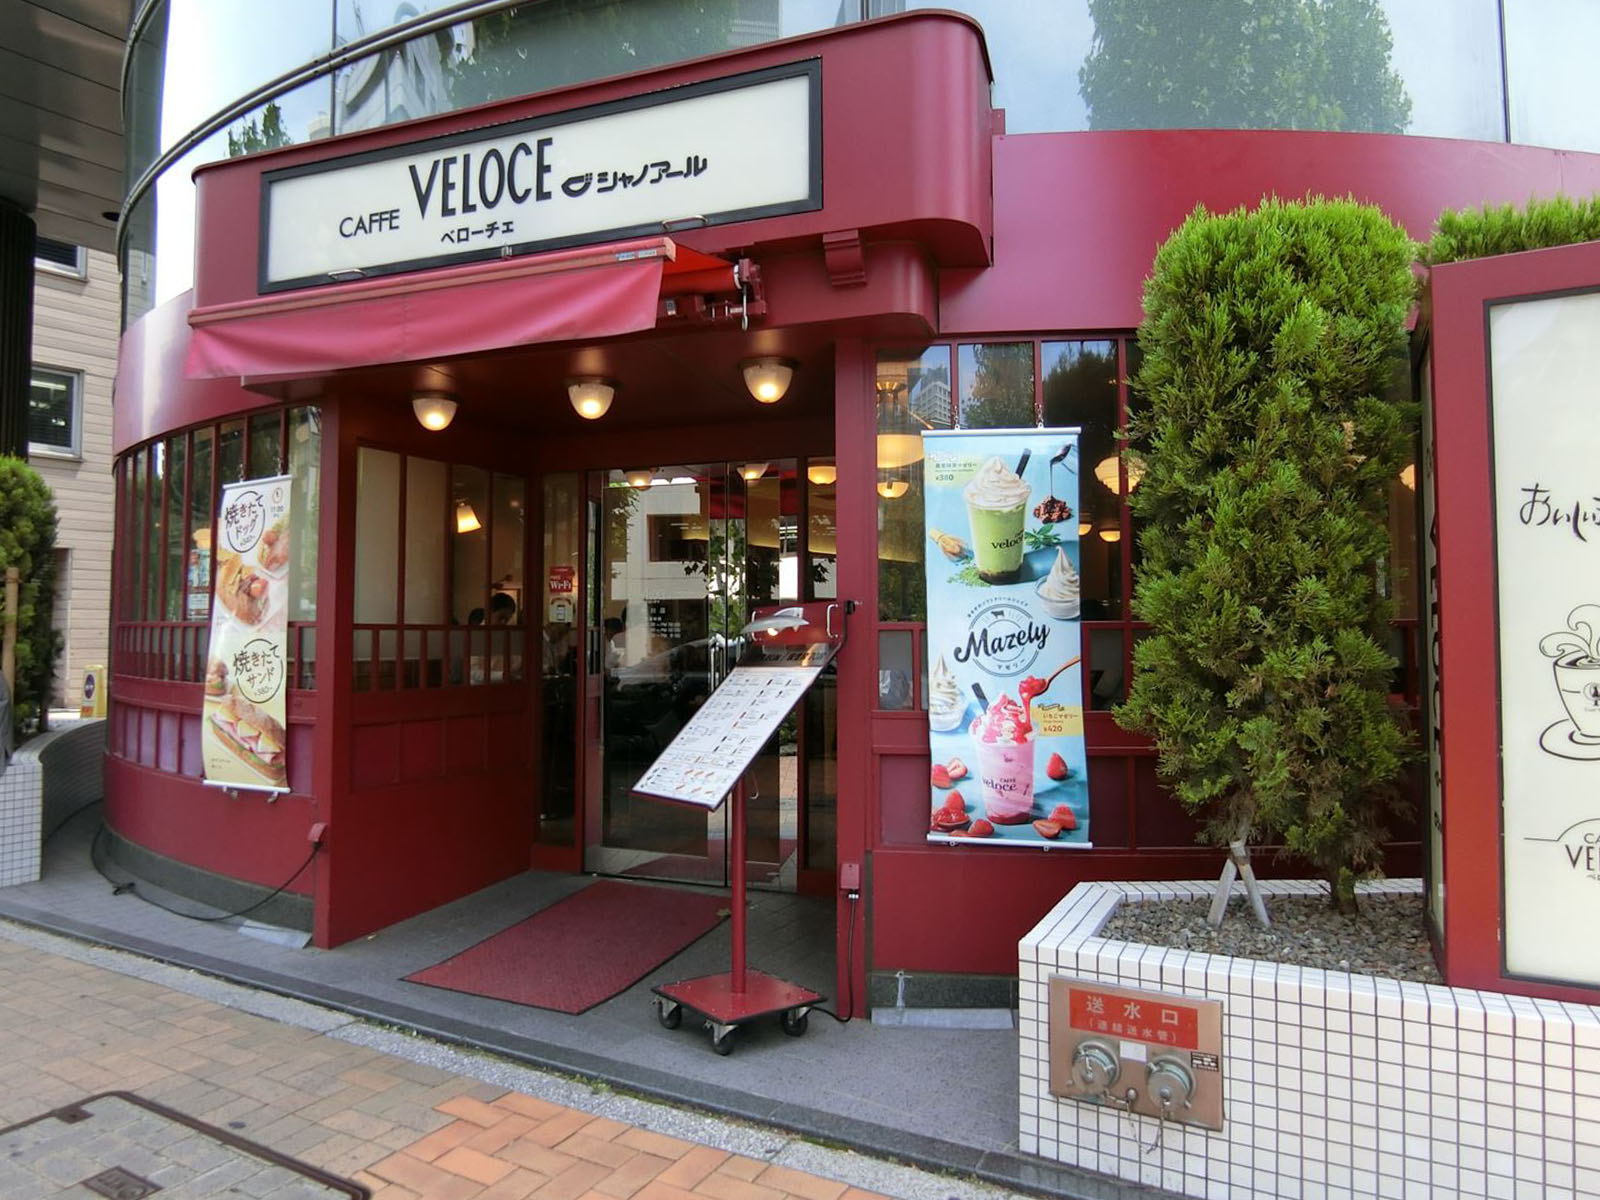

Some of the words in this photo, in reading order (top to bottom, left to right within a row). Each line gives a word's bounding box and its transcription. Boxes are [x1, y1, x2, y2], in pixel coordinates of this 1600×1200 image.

[339, 208, 401, 239] CAFFE
[408, 136, 553, 221] VELOCE
[596, 154, 708, 194] シャノアール
[440, 220, 515, 244] ベローチェ
[1519, 482, 1600, 543] おいしい
[550, 580, 572, 590] Wi-Fi
[953, 620, 1051, 663] Mazely
[232, 644, 280, 677] 焼きたて
[246, 666, 275, 689] サンド
[1564, 844, 1600, 871] VE
[1086, 995, 1179, 1026] 送水口
